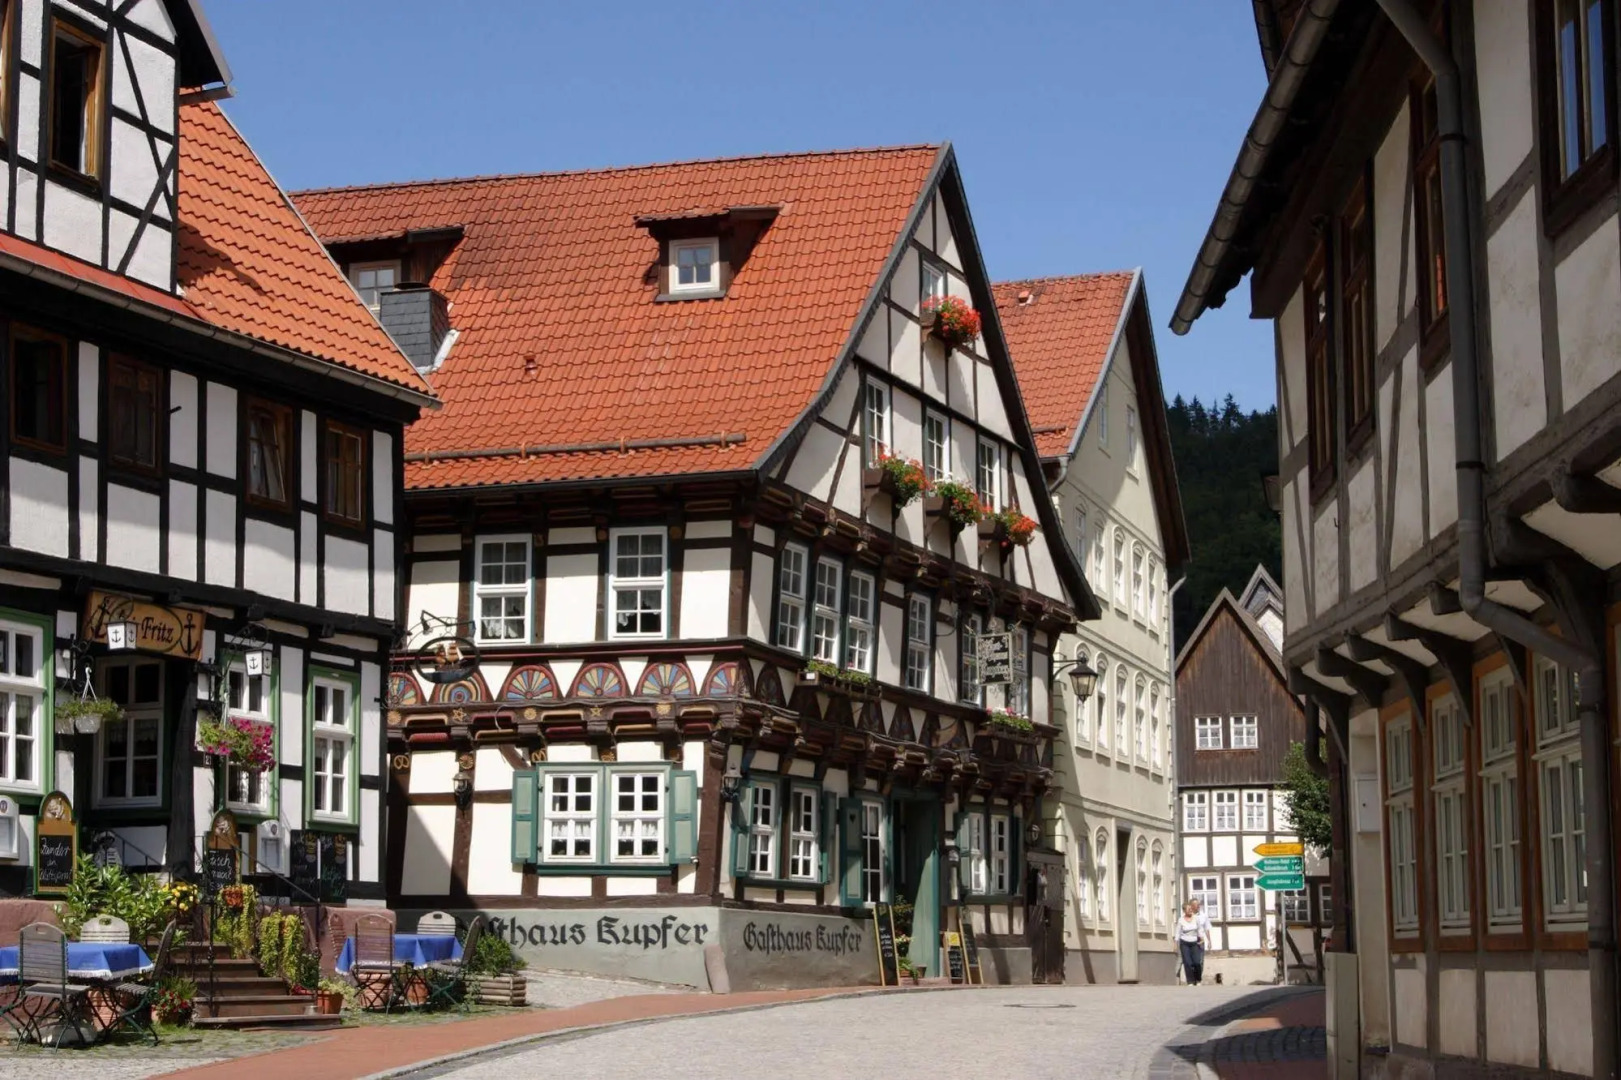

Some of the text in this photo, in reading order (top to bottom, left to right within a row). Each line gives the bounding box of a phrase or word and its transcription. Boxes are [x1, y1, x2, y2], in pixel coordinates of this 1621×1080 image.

[141, 616, 174, 644] Fritz
[597, 914, 709, 949] Kupfer
[816, 924, 862, 955] Kupfer
